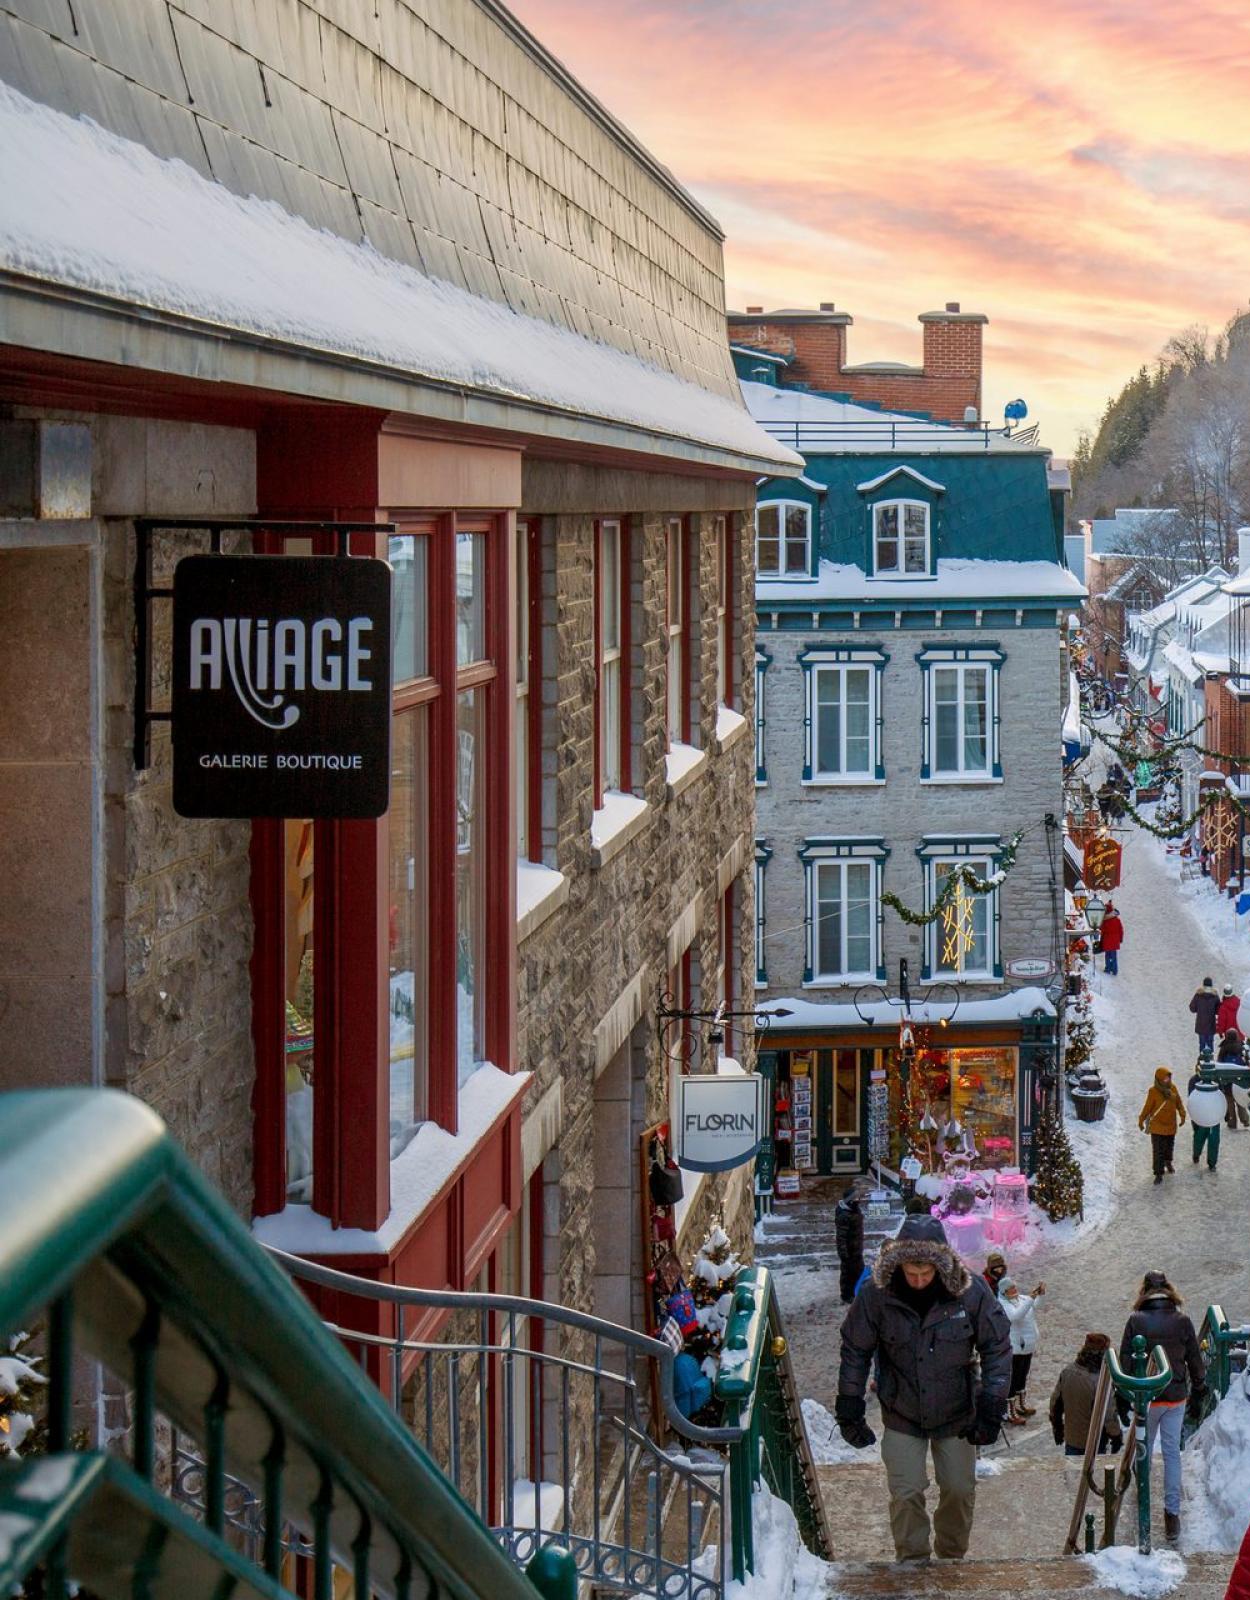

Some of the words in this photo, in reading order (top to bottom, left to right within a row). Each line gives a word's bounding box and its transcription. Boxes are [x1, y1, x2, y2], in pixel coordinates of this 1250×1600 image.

[199, 754, 268, 769] GALERIE
[277, 755, 362, 770] BOUTIQUE
[685, 1113, 755, 1131] FLORIN
